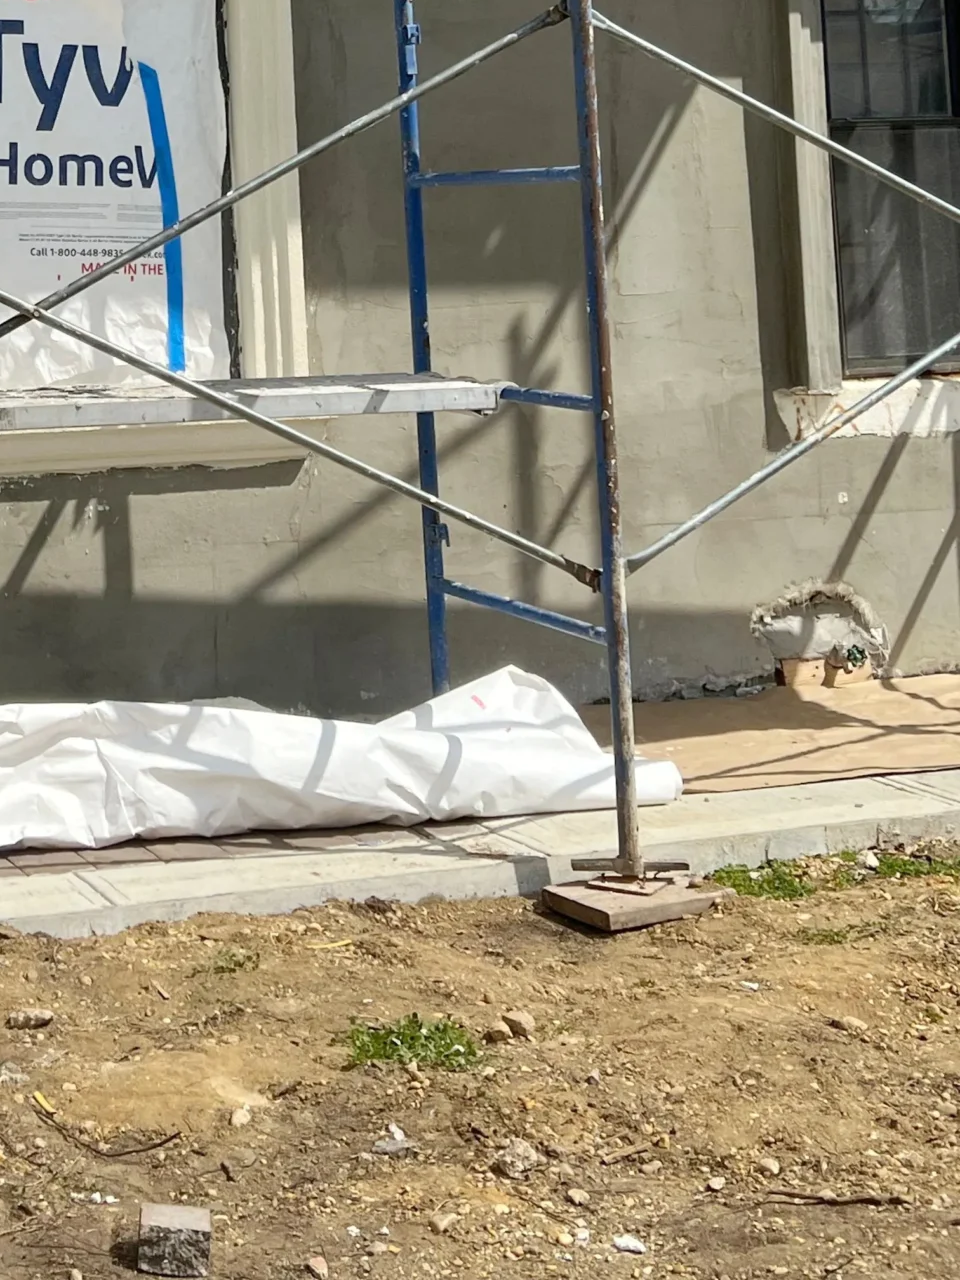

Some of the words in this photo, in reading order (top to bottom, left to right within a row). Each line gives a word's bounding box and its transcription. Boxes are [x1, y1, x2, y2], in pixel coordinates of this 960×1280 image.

[29, 246, 49, 258] Call
[123, 263, 138, 276] IN
[140, 263, 164, 276] THE
